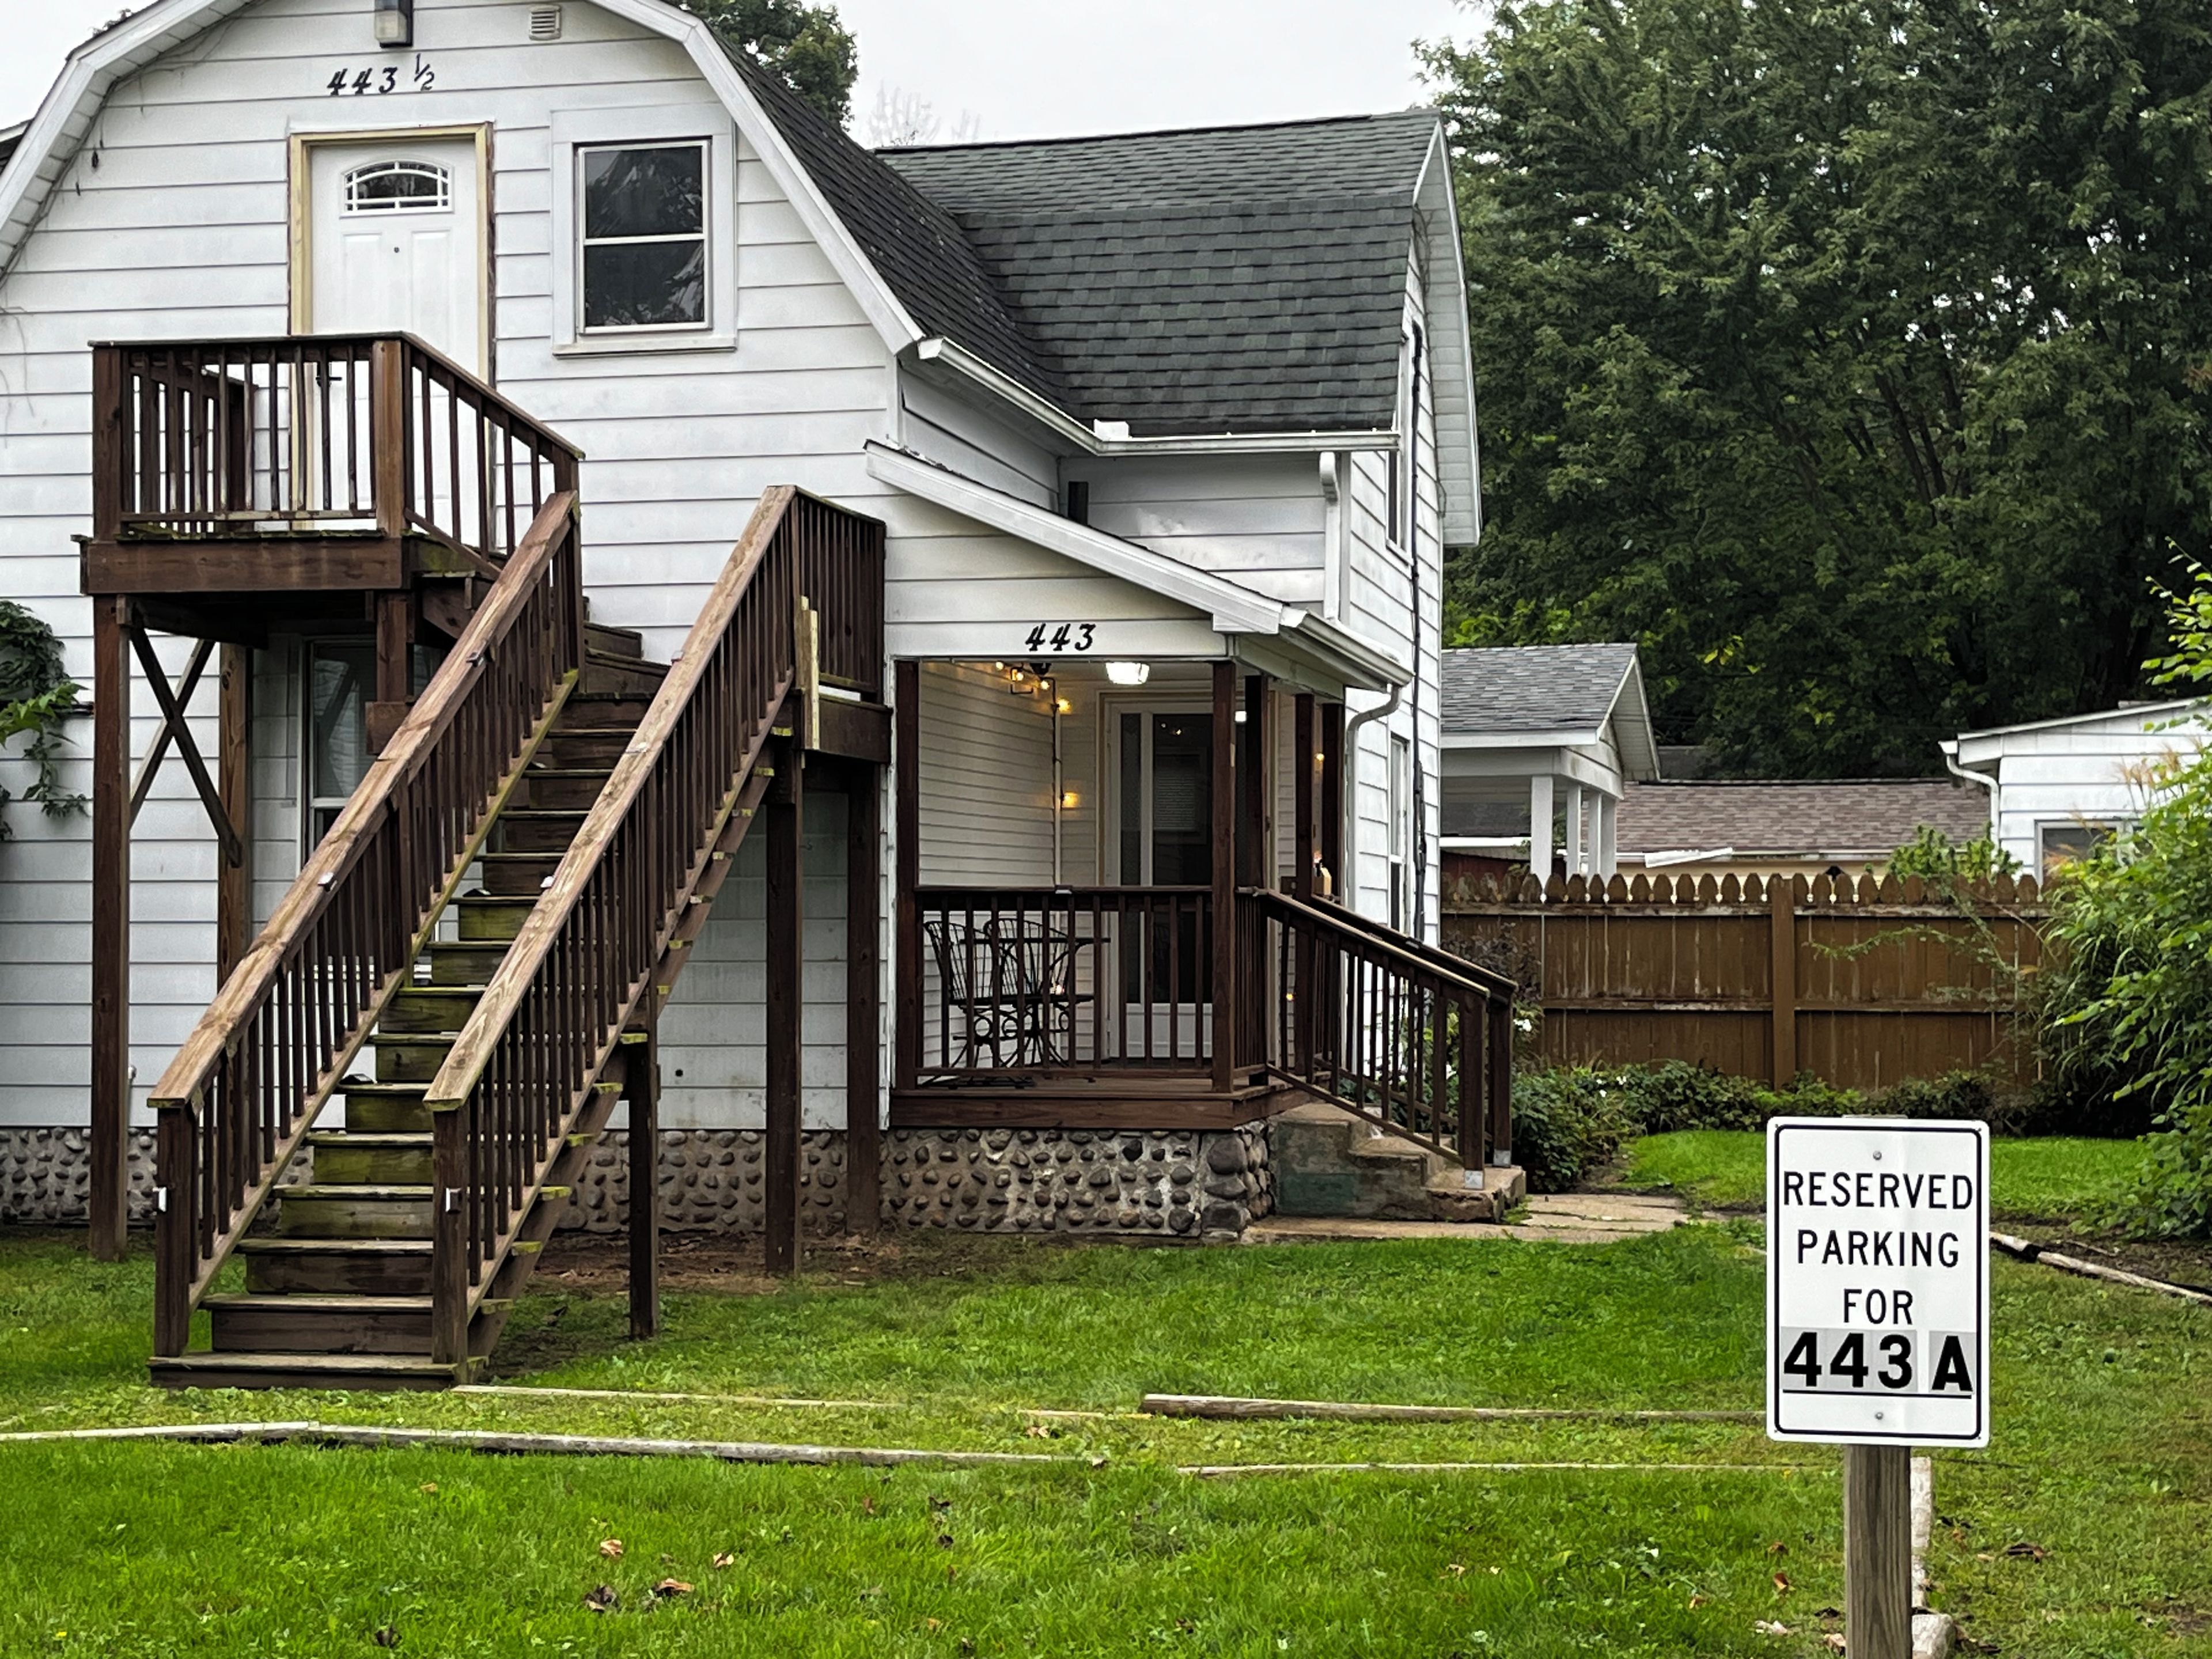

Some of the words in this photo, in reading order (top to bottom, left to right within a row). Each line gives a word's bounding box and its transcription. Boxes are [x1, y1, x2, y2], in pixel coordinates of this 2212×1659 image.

[327, 66, 398, 96] 443
[1025, 623, 1096, 652] 443
[1783, 1171, 1973, 1210] RESERVED
[1797, 1229, 1959, 1268] PARKING
[1843, 1288, 1914, 1325] FOR
